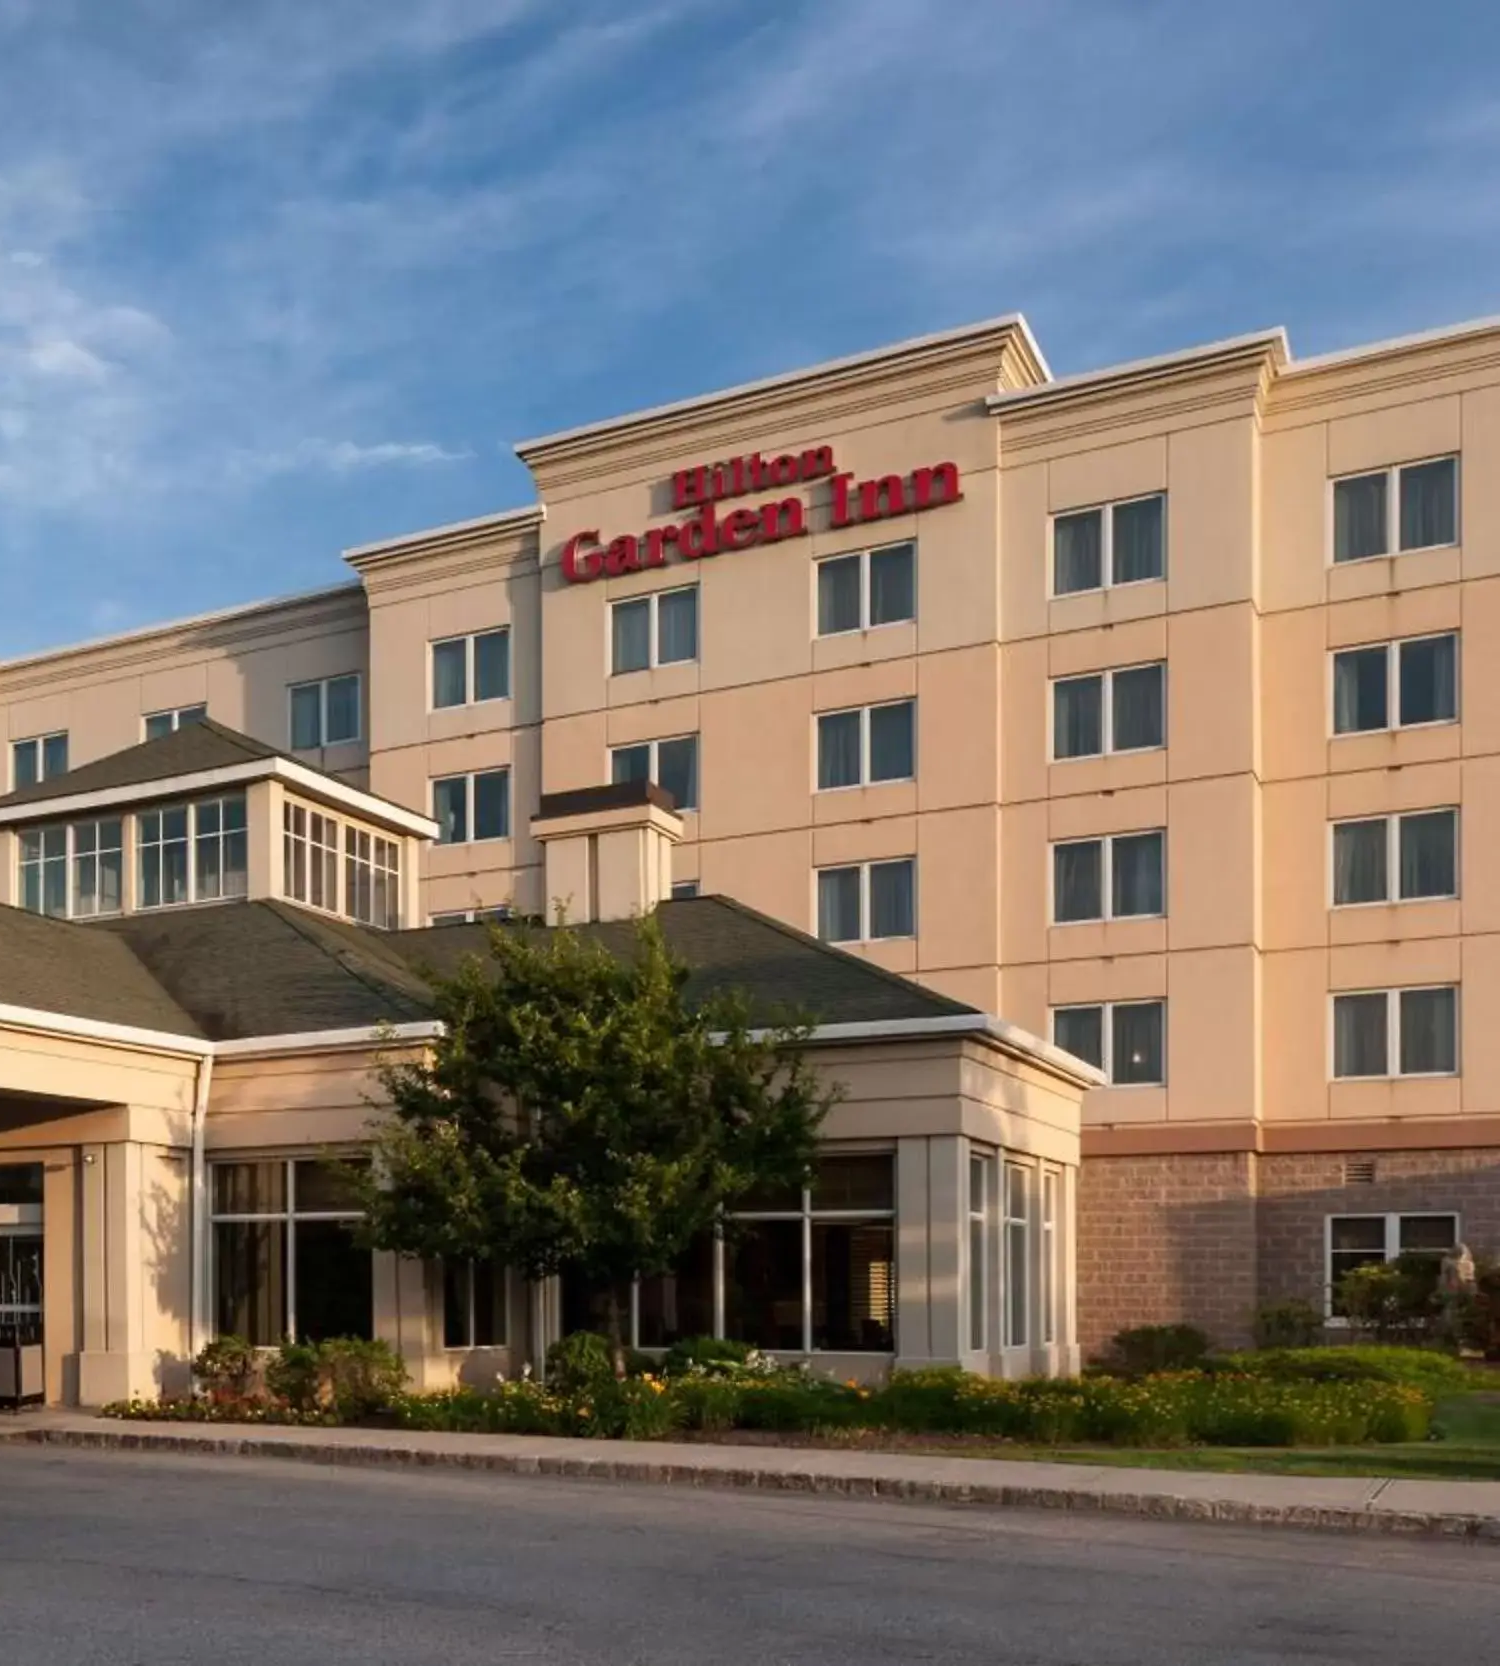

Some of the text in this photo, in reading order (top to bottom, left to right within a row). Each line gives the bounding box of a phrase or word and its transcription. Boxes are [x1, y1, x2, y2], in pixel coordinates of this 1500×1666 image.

[561, 461, 964, 583] Garden Inn
[672, 444, 837, 511] Hilton
